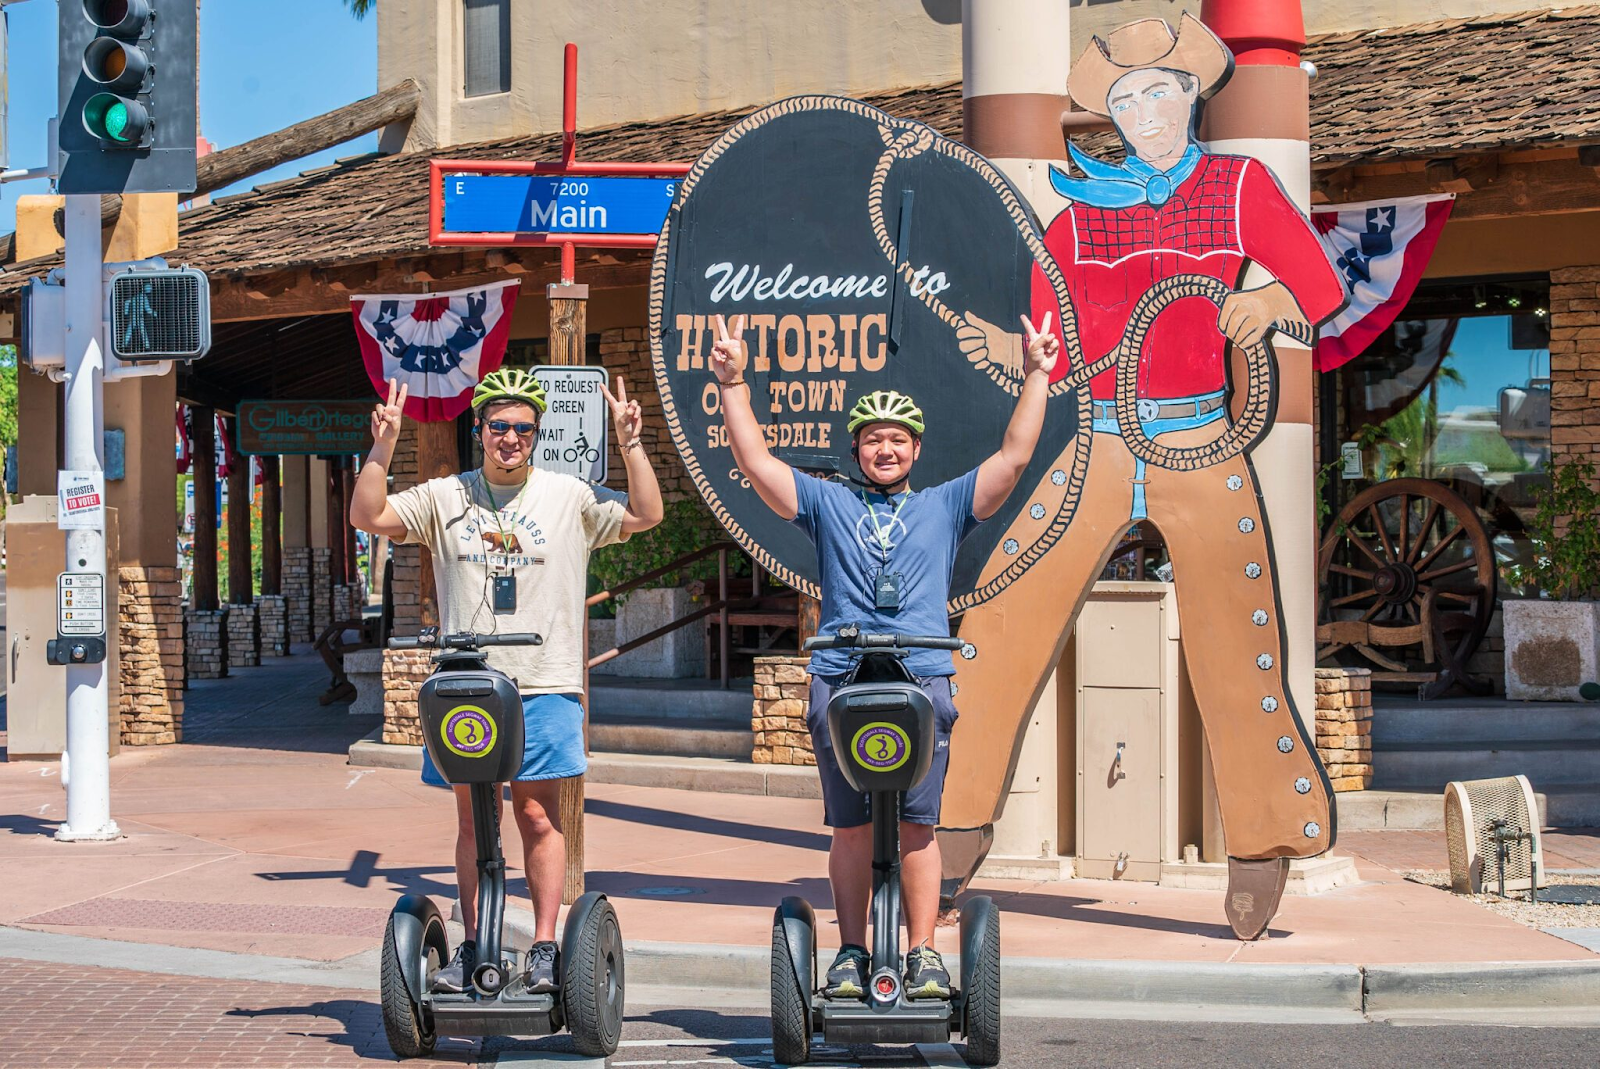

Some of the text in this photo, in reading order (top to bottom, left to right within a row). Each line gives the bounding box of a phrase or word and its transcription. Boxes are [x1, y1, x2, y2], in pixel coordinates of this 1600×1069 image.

[456, 182, 675, 197] E 7200 S
[531, 200, 607, 228] Main
[705, 262, 951, 303] Welcome to
[537, 380, 599, 393] TO REQUEST
[770, 380, 847, 413] TOWN
[552, 400, 585, 414] GREEN
[315, 432, 364, 441] GALLERY
[539, 428, 565, 441] WAIT
[707, 423, 831, 448] SCSDALE
[543, 448, 560, 461] ON
[66, 484, 95, 497] REGISTER
[68, 495, 97, 508] TO VOTE!
[466, 554, 486, 563] AND
[938, 740, 949, 748] FILA
